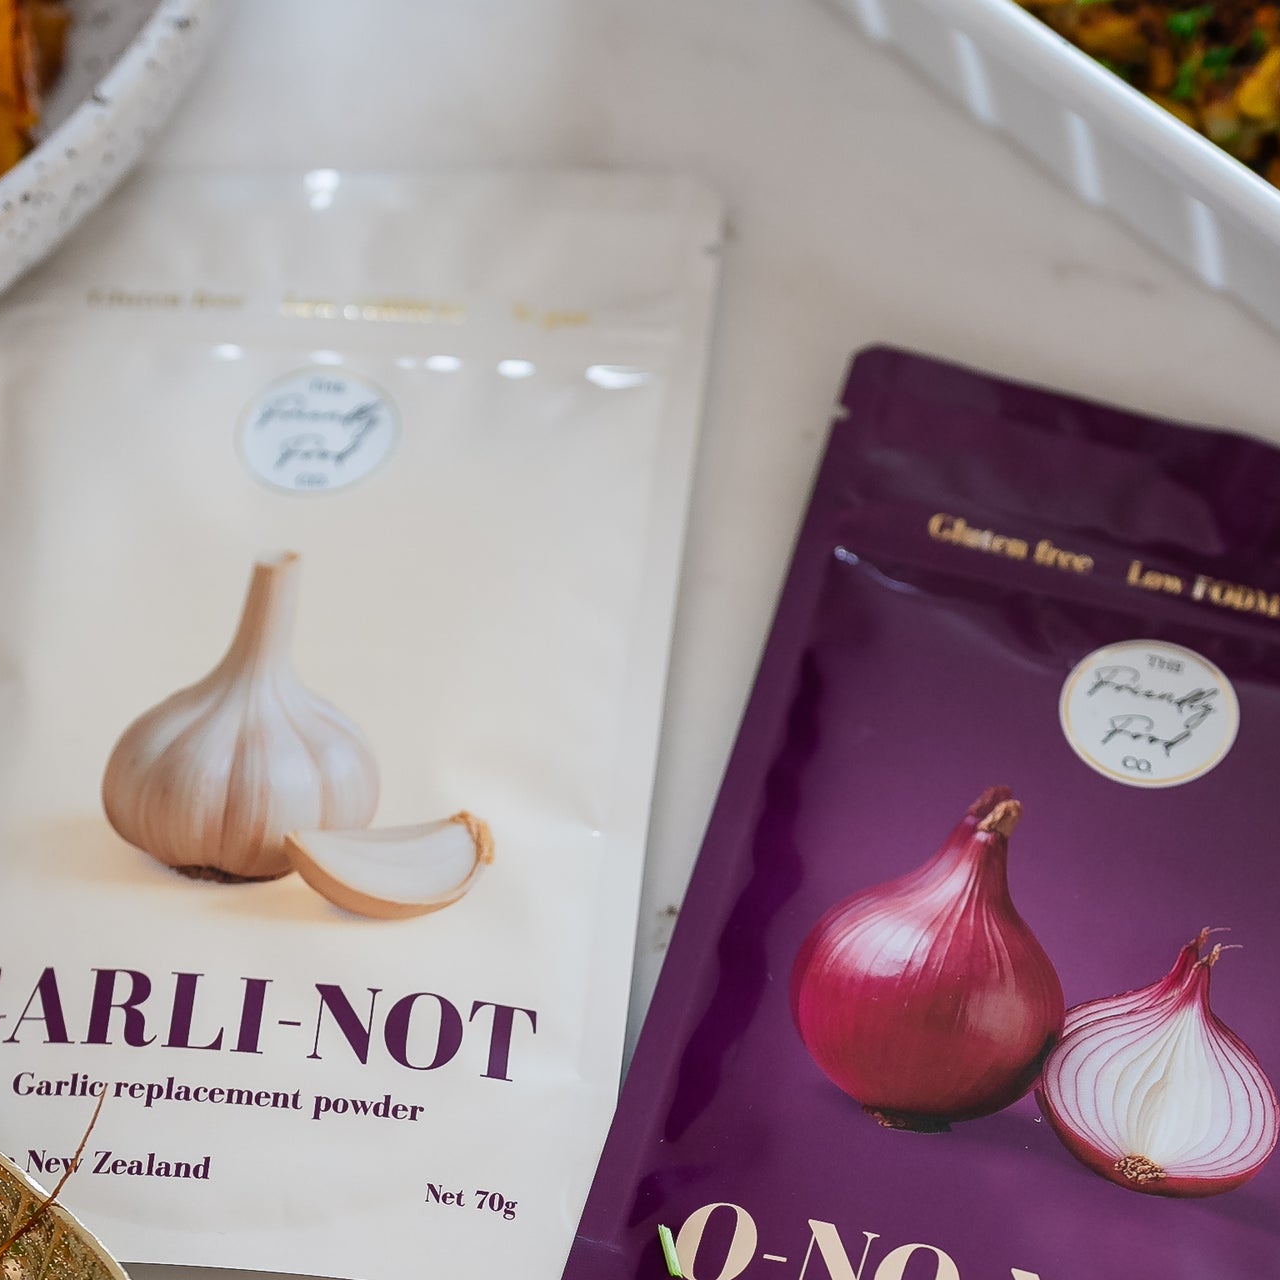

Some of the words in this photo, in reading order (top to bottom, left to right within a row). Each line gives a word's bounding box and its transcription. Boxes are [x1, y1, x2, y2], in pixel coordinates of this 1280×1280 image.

[1086, 665, 1220, 730] Friendly
[12, 1071, 106, 1098] Garlic
[113, 1076, 304, 1111] replacement
[312, 1094, 425, 1123] powder
[25, 1149, 84, 1174] New
[92, 1150, 212, 1180] Zealand
[424, 1182, 466, 1208] Net
[474, 1189, 519, 1220] 70g
